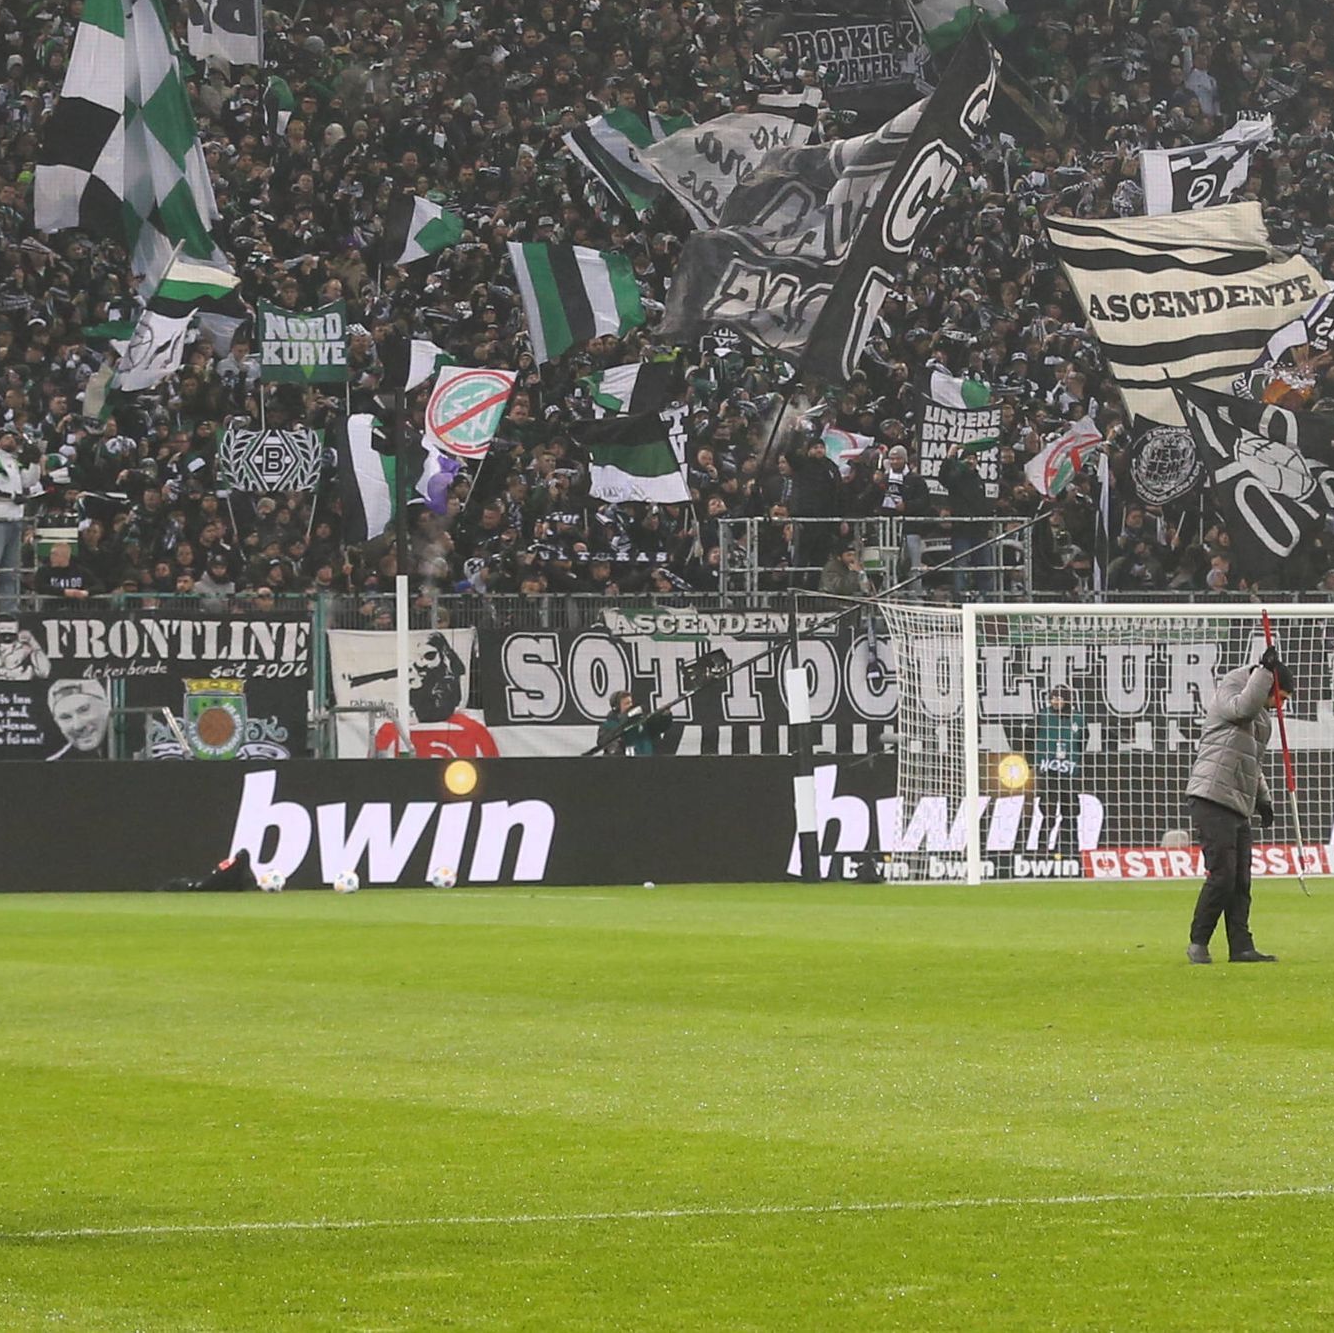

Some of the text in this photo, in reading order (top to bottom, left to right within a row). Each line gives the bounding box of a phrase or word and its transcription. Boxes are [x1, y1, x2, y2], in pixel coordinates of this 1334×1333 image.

[1088, 273, 1318, 322] ASCENDENTE
[263, 312, 342, 341] NORD
[261, 340, 347, 366] KURVE
[924, 404, 1002, 428] UNSERE
[611, 610, 842, 637] ASCENDENTE
[40, 618, 312, 664] FRONTLINE
[210, 662, 246, 679] seit
[252, 662, 308, 680] 2006
[1040, 759, 1077, 775] HOST
[228, 758, 556, 885] bwin
[929, 854, 995, 879] bwn
[1014, 852, 1080, 878] bwin
[1124, 849, 1289, 878] STRSS
